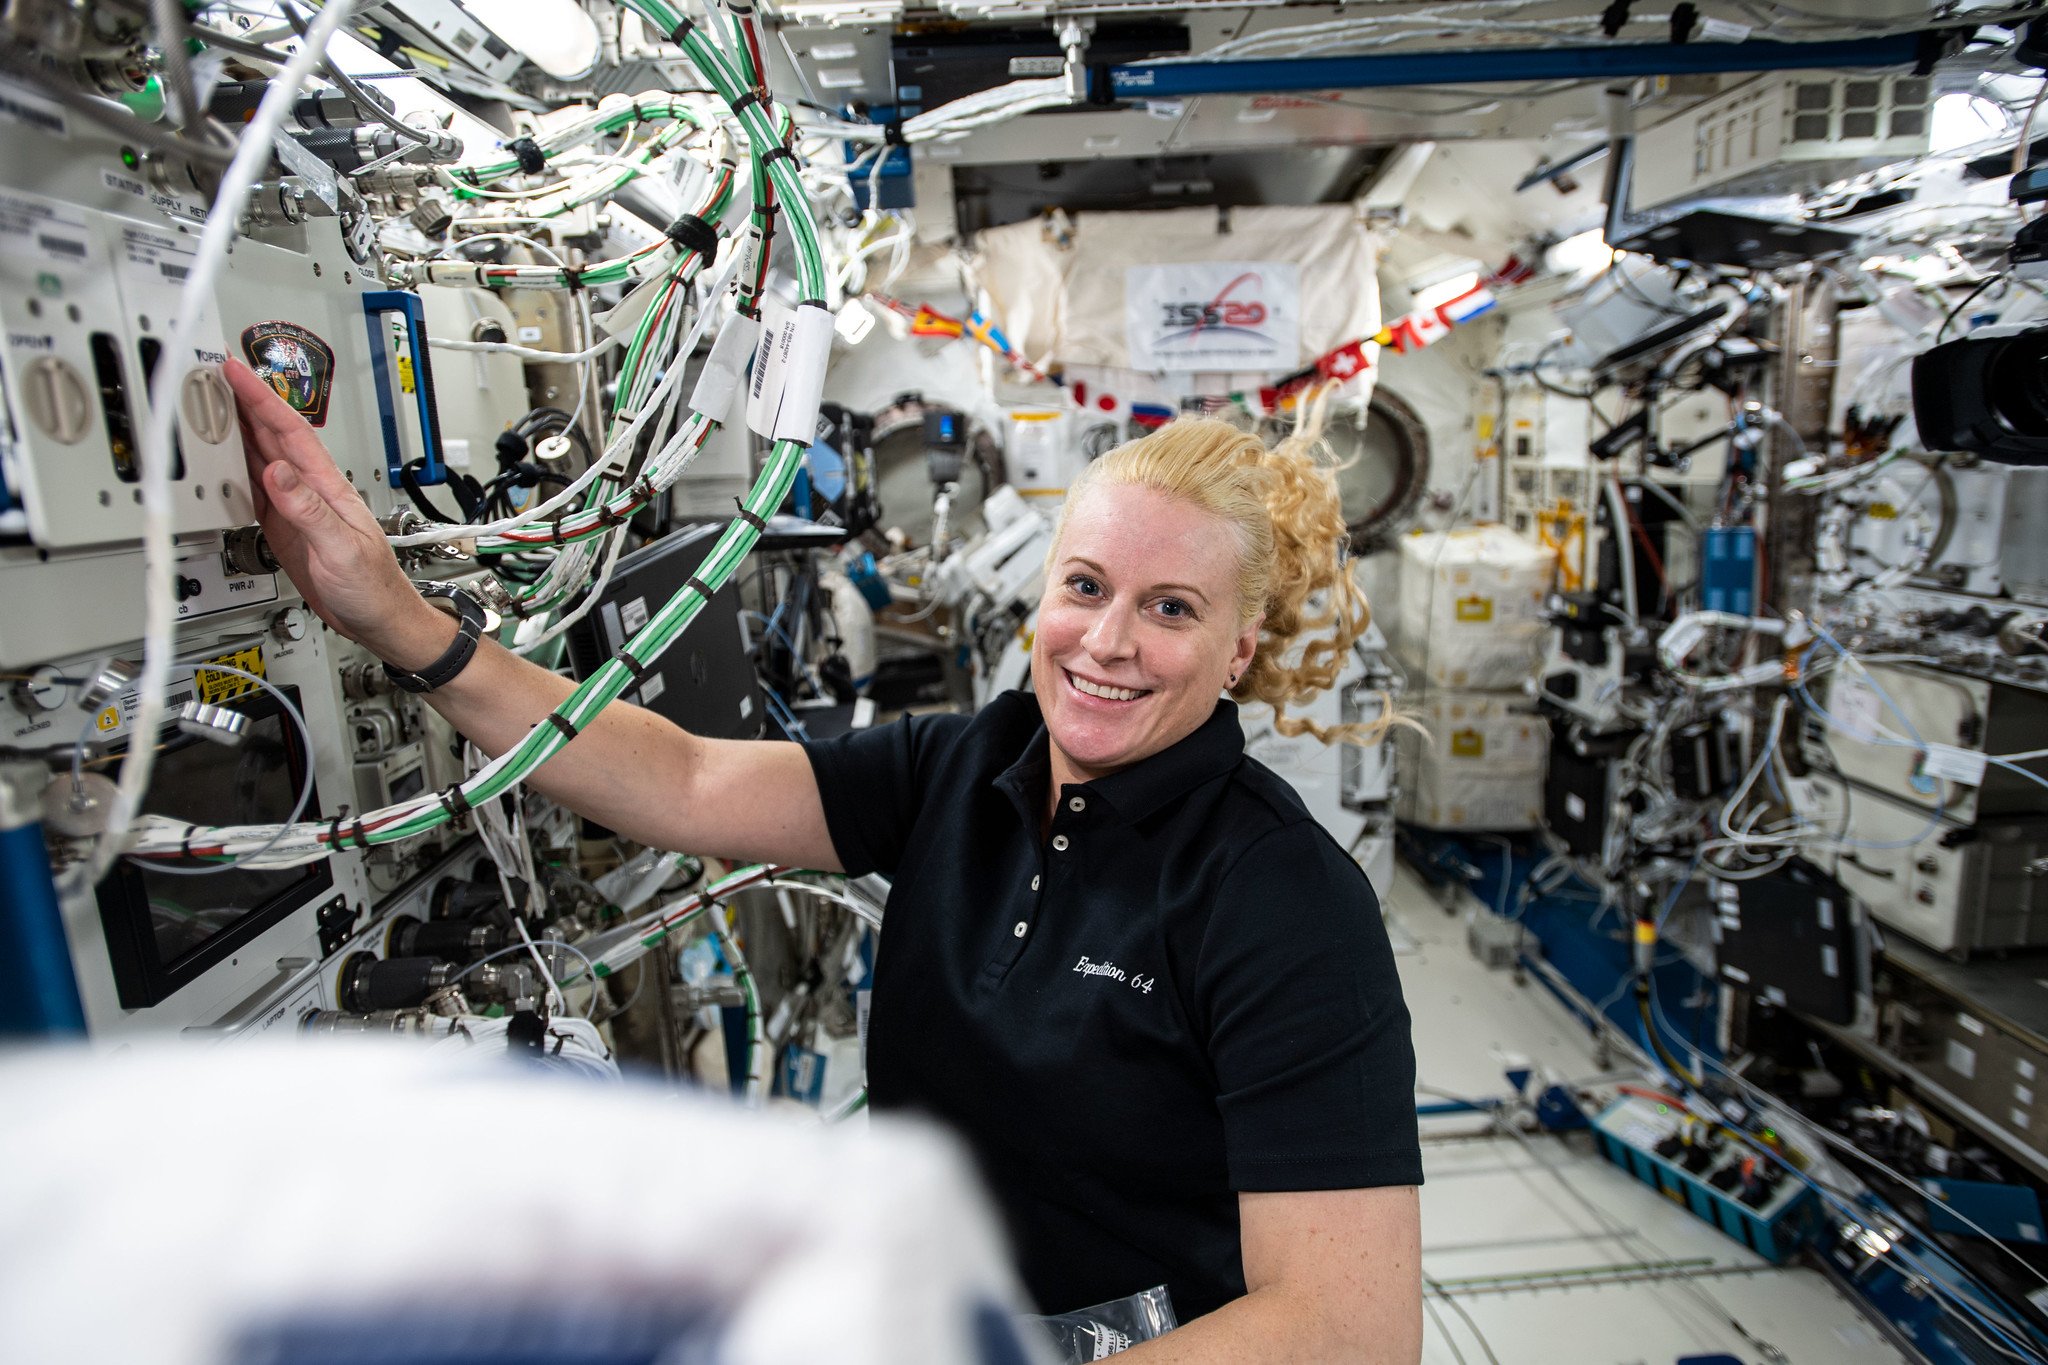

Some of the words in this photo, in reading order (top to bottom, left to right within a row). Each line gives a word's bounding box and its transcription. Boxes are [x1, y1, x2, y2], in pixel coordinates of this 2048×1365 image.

[105, 173, 145, 196] STATUS
[150, 193, 182, 212] SUPPLY
[358, 267, 375, 279] CLOSE
[200, 350, 226, 364] OPEN
[229, 581, 246, 593] PWR
[247, 580, 255, 590] J1
[206, 671, 220, 683] COLD
[1073, 956, 1127, 982] Expedition
[1131, 973, 1155, 994] 64
[262, 1007, 286, 1031] LAPTOP
[1117, 1332, 1127, 1349] ght
